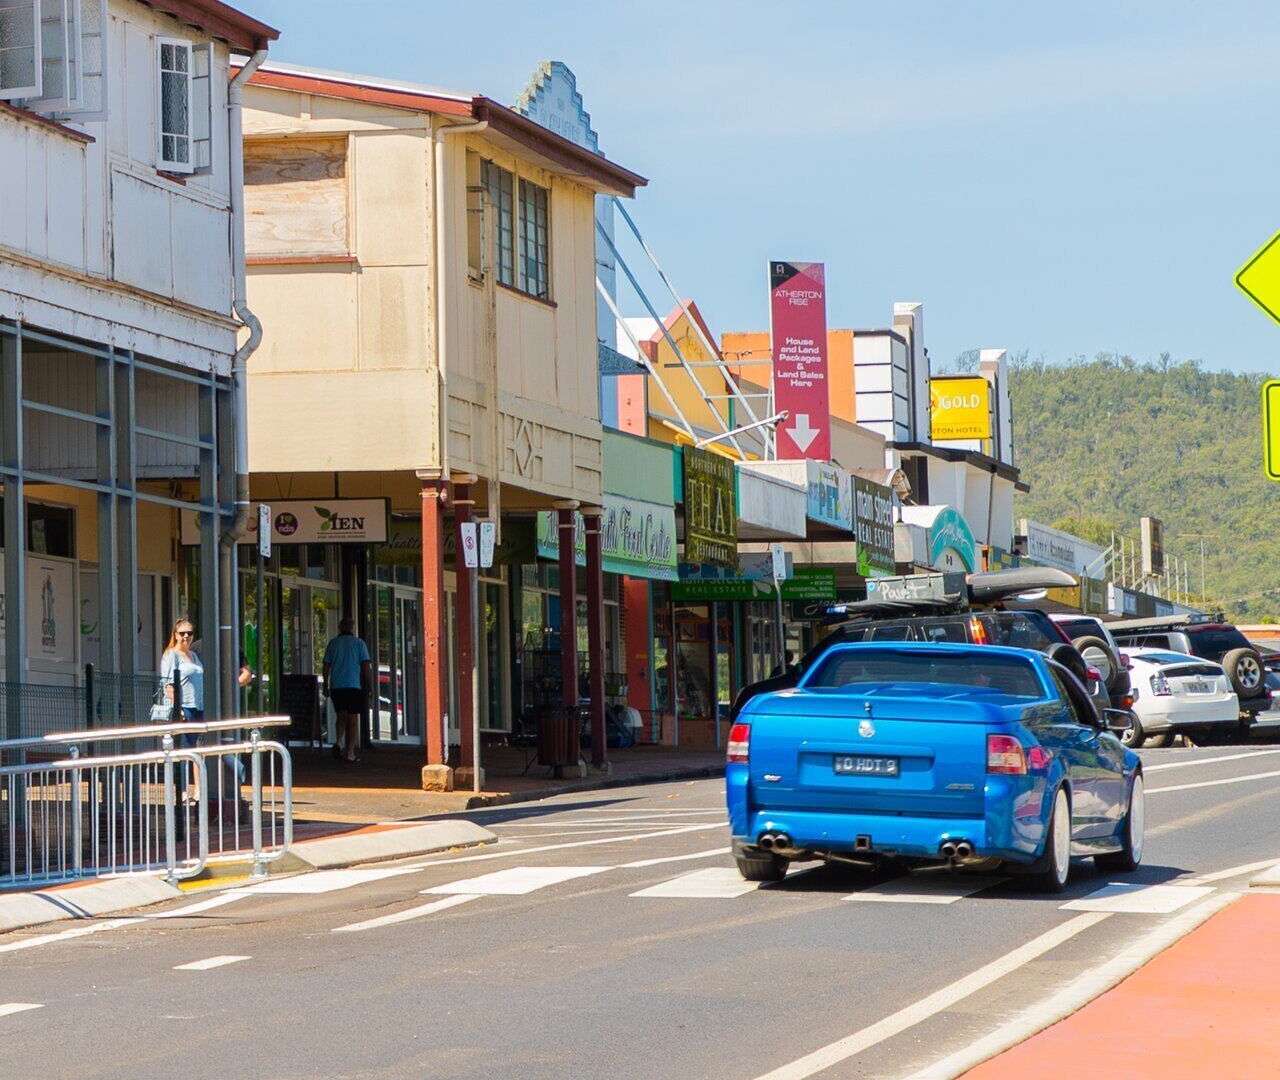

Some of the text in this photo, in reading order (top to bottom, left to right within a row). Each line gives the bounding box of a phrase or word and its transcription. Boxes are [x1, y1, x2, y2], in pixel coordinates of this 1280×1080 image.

[775, 289, 822, 299] ATHERTON
[789, 298, 809, 306] RISE
[785, 337, 814, 346] House
[798, 346, 819, 354] Land
[779, 353, 821, 364] Packages
[778, 370, 824, 379] Land Sales
[791, 379, 813, 388] Here
[941, 393, 981, 410] GOLD
[956, 425, 984, 434] HOTEL
[688, 477, 735, 536] THAI
